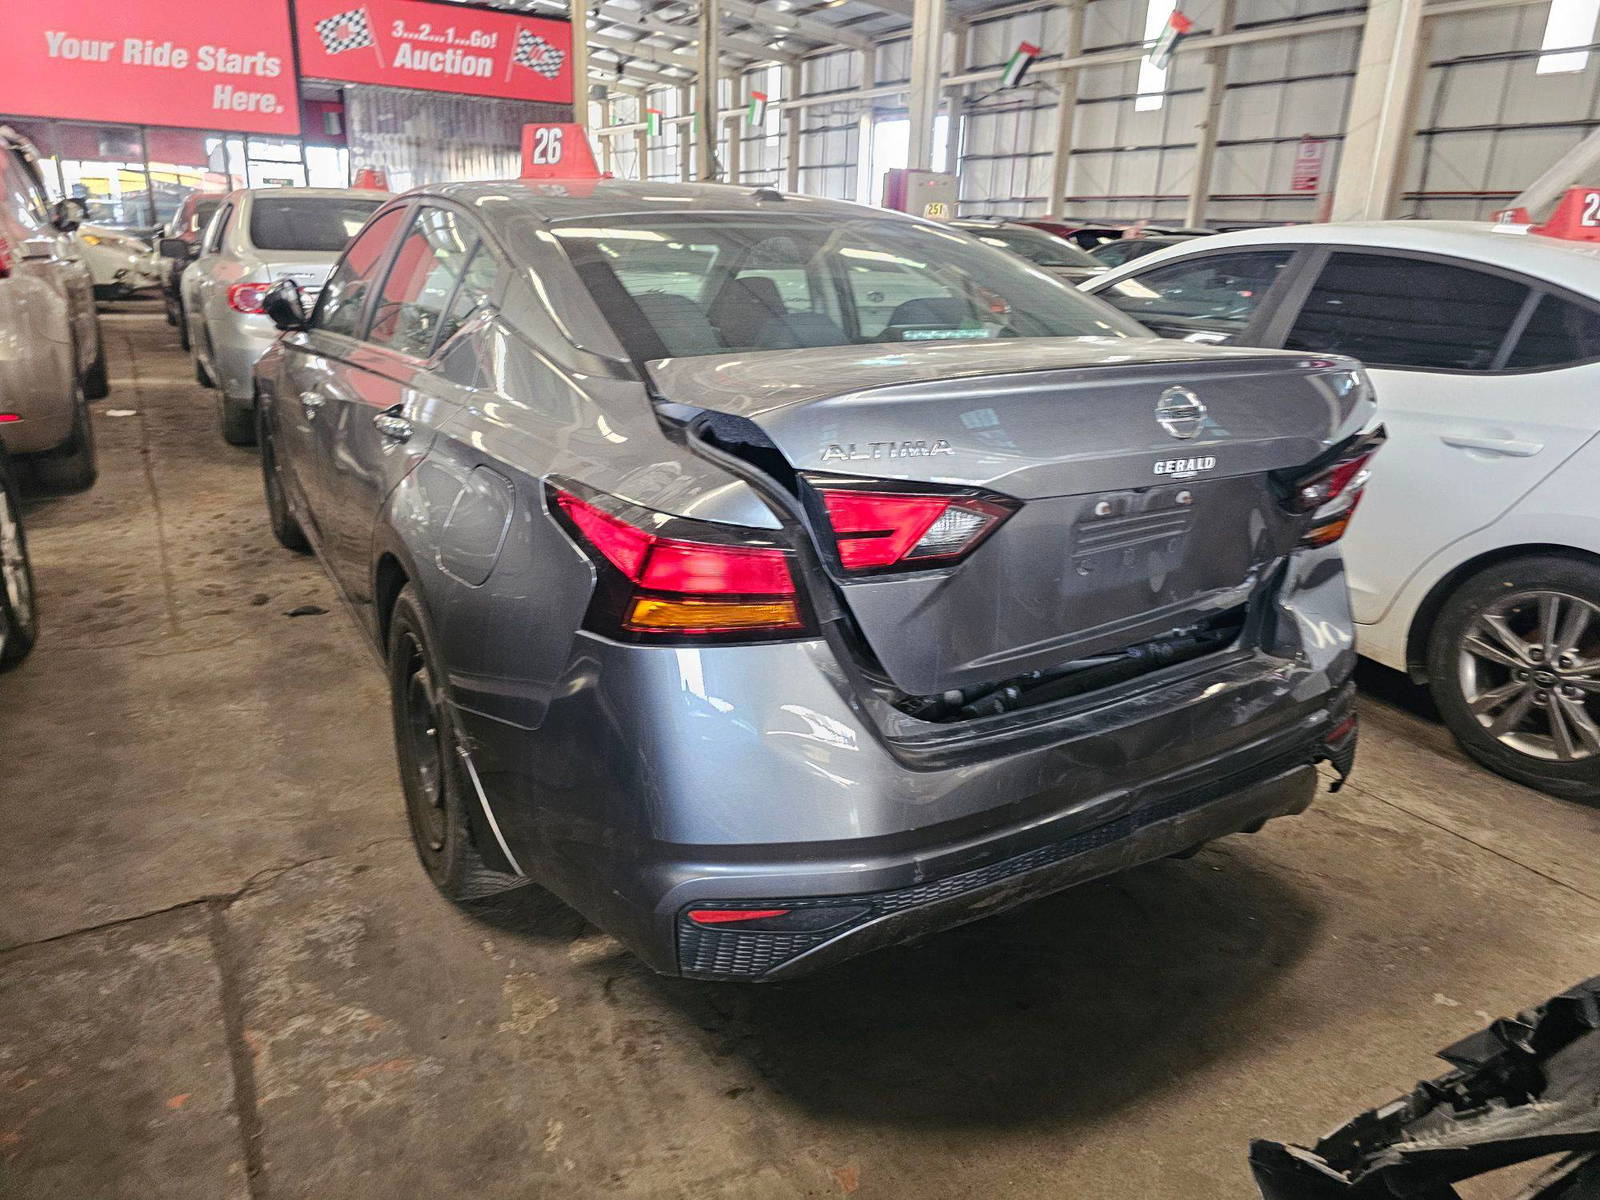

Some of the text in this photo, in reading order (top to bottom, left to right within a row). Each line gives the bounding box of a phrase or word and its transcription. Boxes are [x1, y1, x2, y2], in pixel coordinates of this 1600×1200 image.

[391, 19, 498, 49] 3...2...1...Go!
[45, 31, 281, 78] Your Ride Starts
[393, 42, 493, 78] Auction
[212, 84, 285, 114] Here.
[533, 127, 562, 165] 26
[928, 203, 943, 215] 251
[1581, 192, 1600, 227] 2
[821, 439, 955, 461] ALTIMA
[1153, 456, 1216, 475] GERALD
